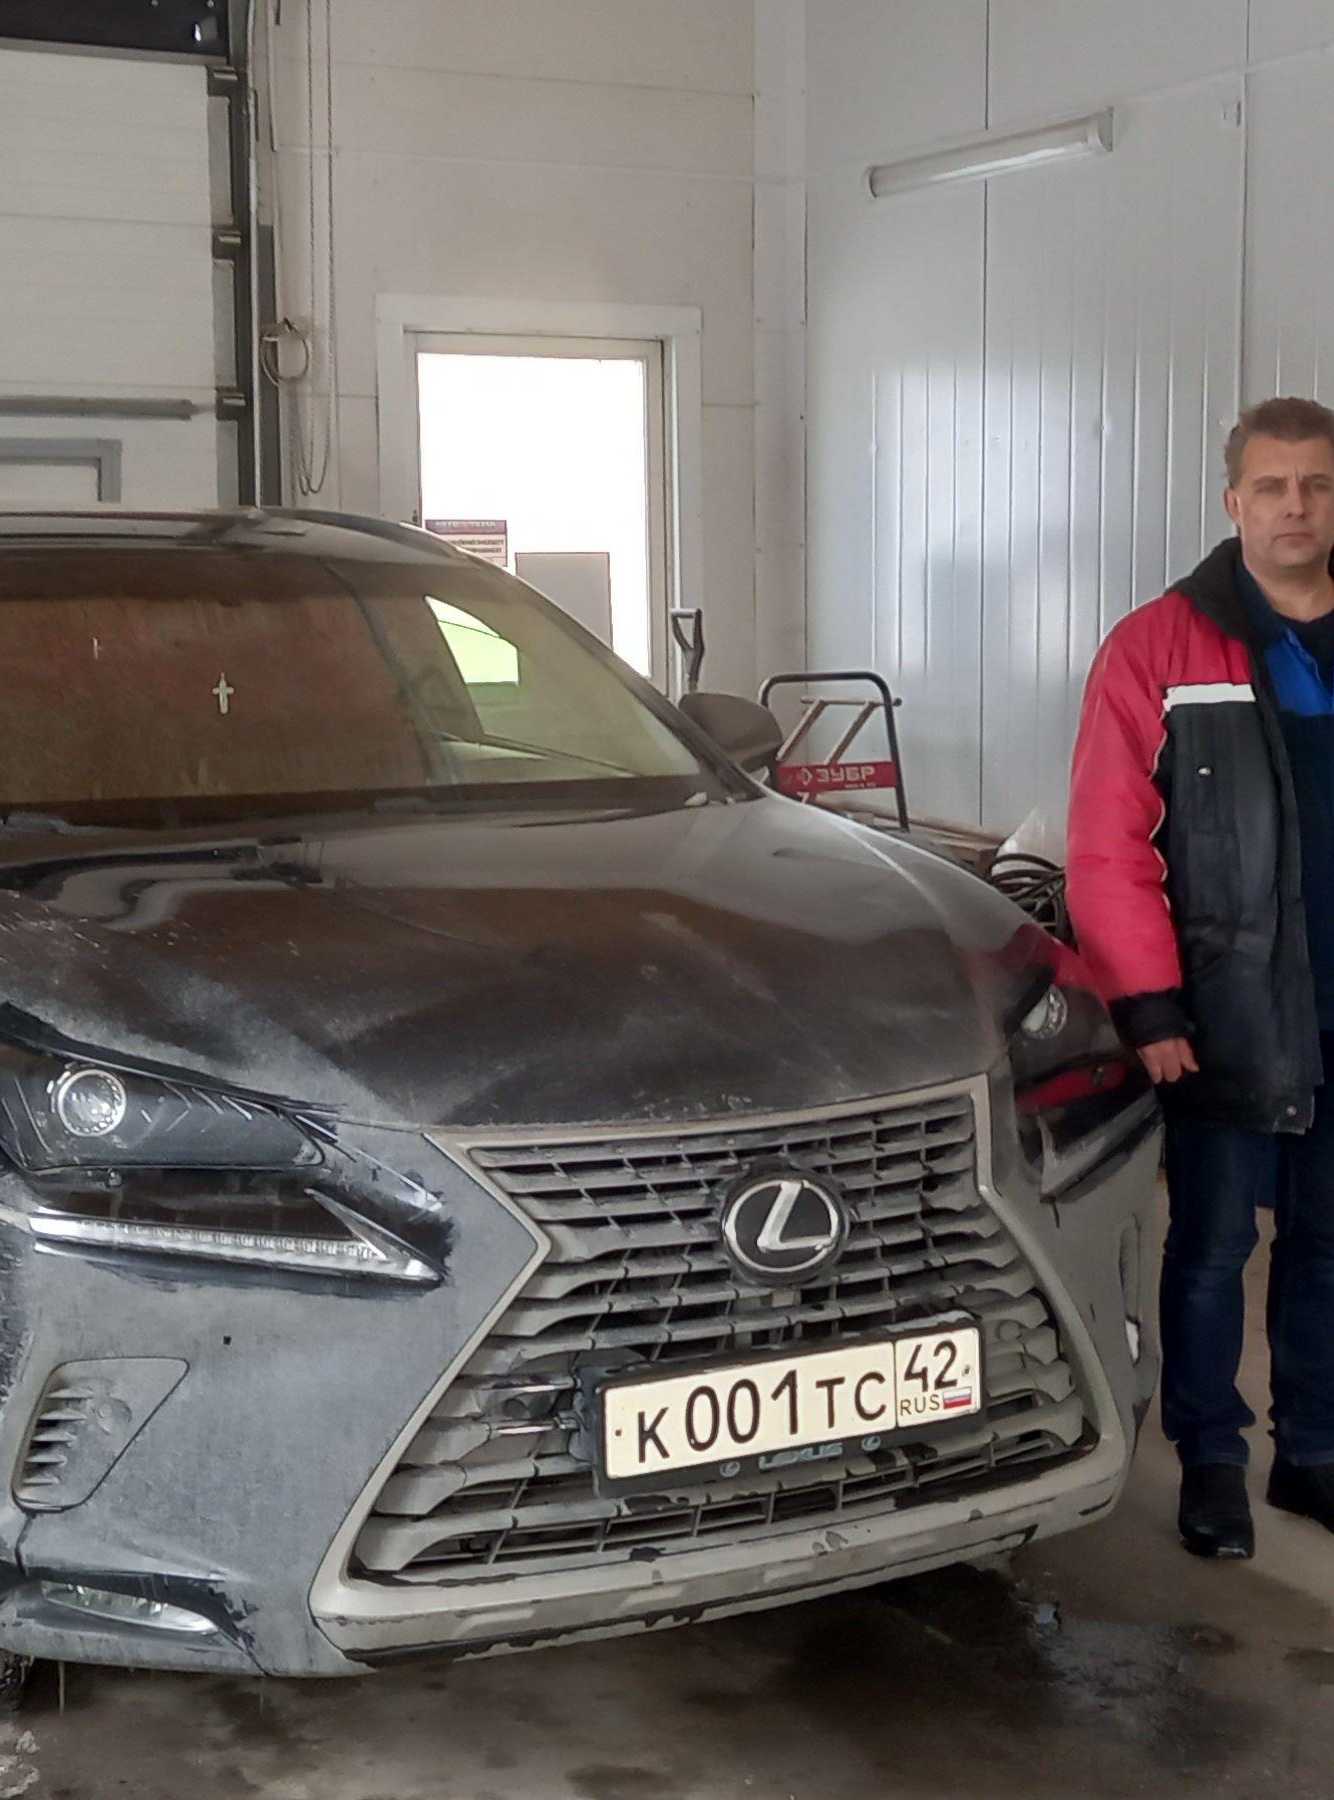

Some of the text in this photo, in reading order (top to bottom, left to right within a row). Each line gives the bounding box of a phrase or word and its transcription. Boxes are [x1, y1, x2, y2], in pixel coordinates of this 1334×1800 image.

[816, 765, 876, 782] ЗУБР
[903, 1339, 958, 1392] 42
[900, 1394, 941, 1416] RUS
